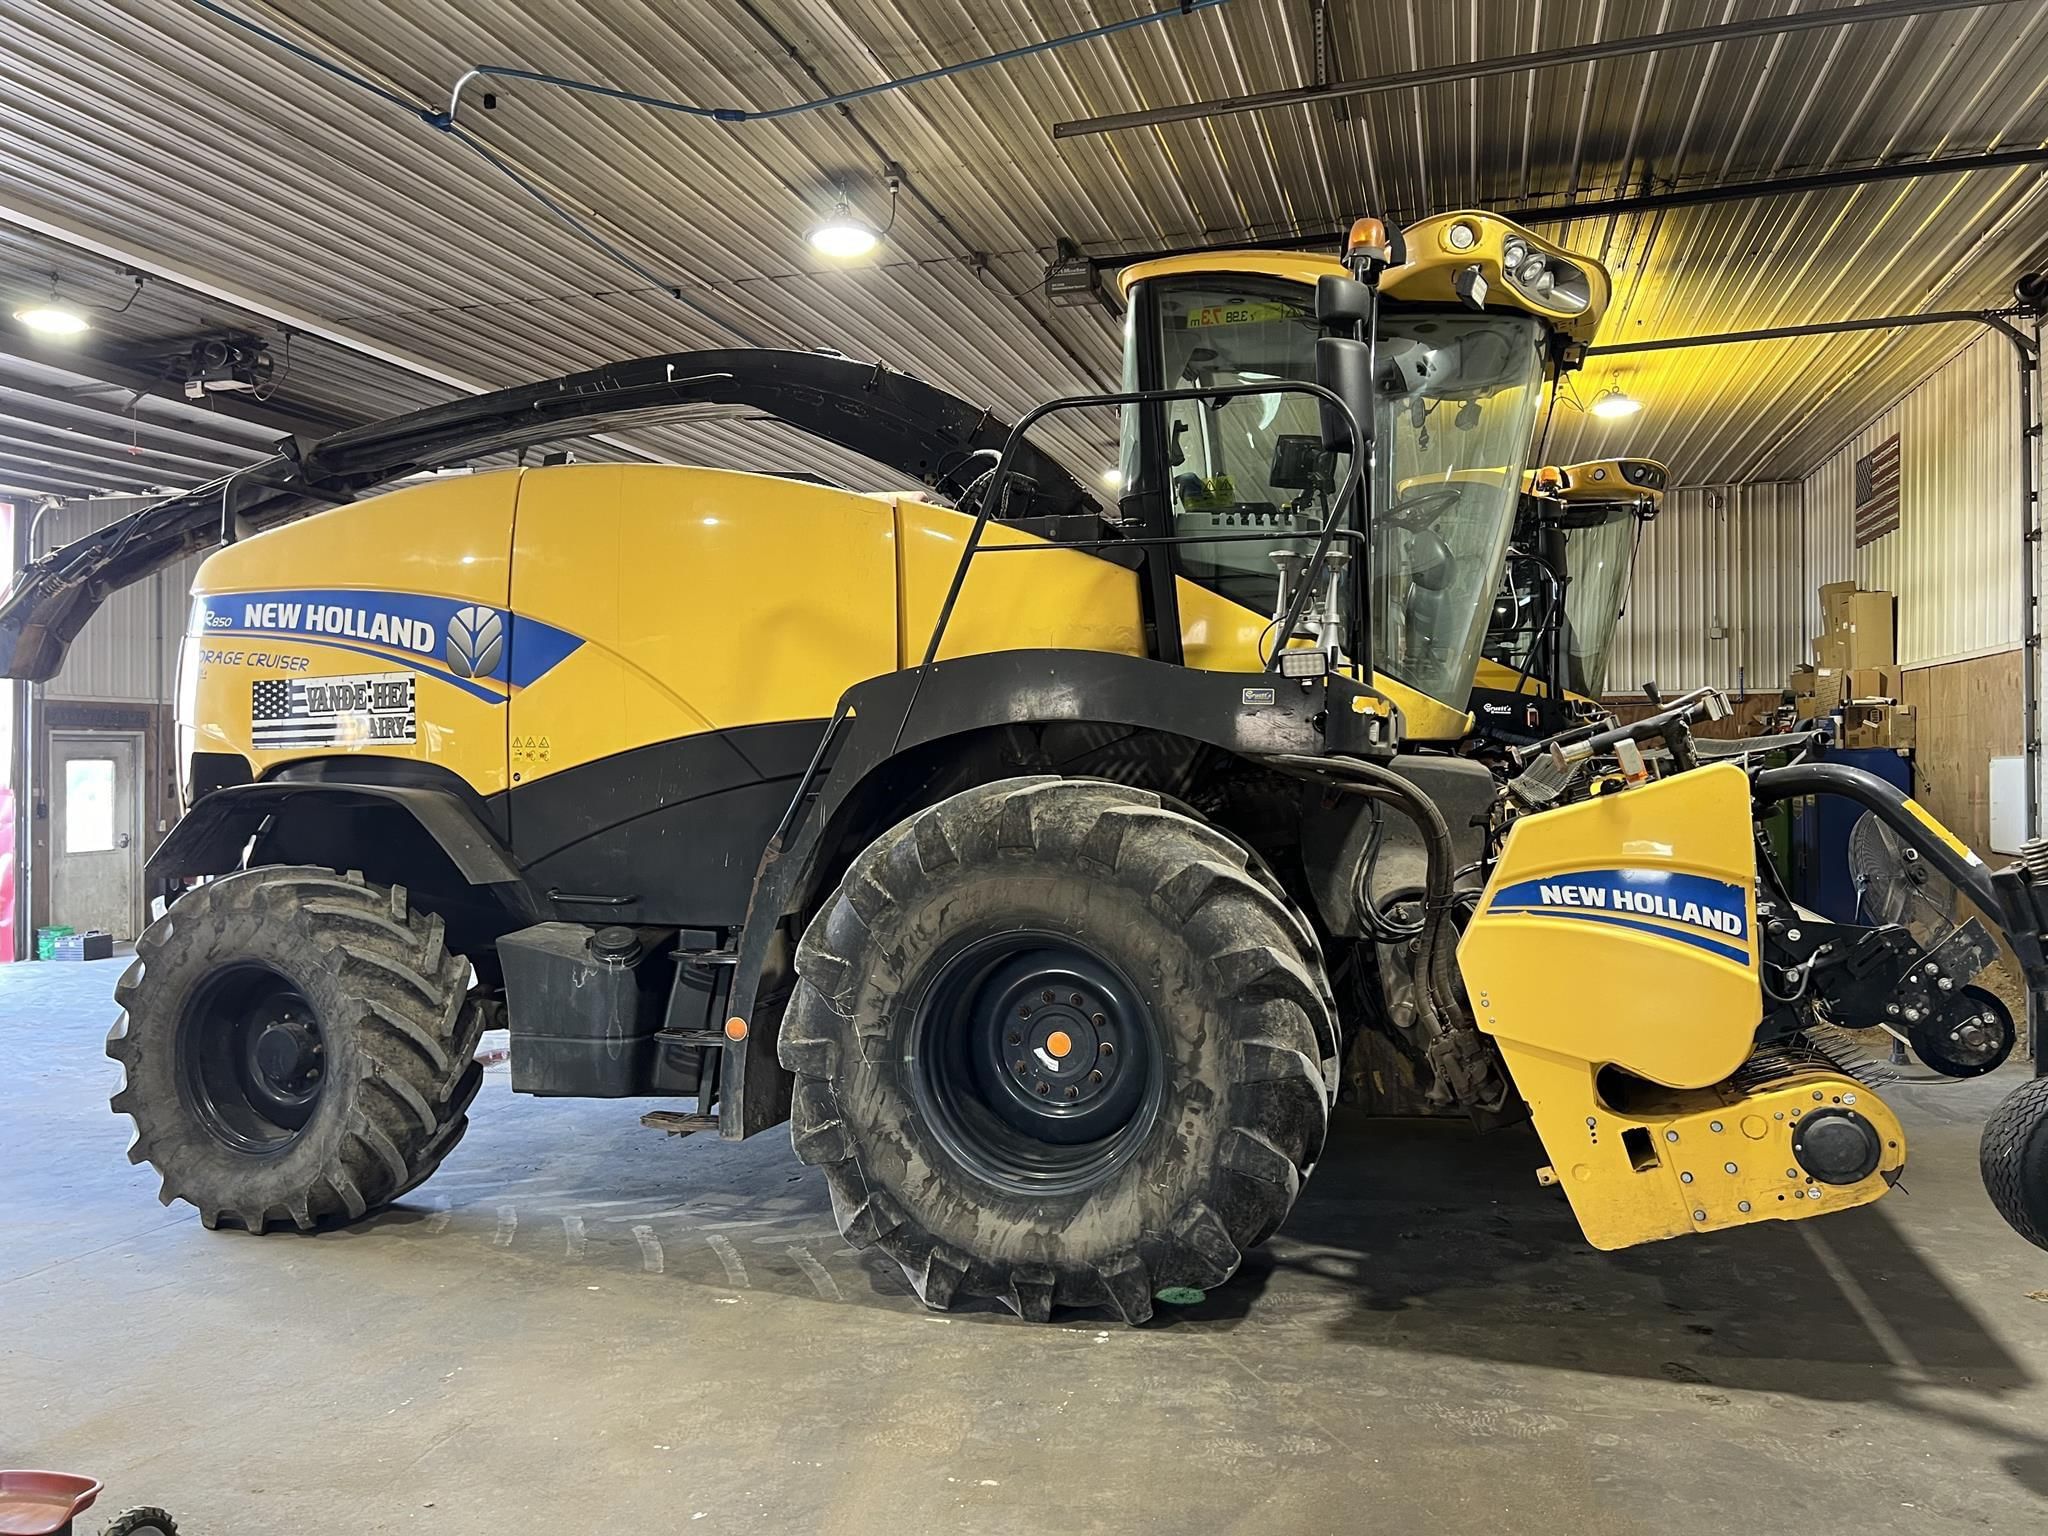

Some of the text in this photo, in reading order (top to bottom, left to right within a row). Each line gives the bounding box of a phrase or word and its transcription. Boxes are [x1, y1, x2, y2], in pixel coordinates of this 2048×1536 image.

[244, 603, 436, 653] NEW HOLLAND
[198, 650, 310, 672] ORAGE CRUISER
[306, 682, 408, 713] VANDE HEI
[355, 716, 407, 739] AIRY
[1540, 885, 1742, 936] NEW HOLLAND
